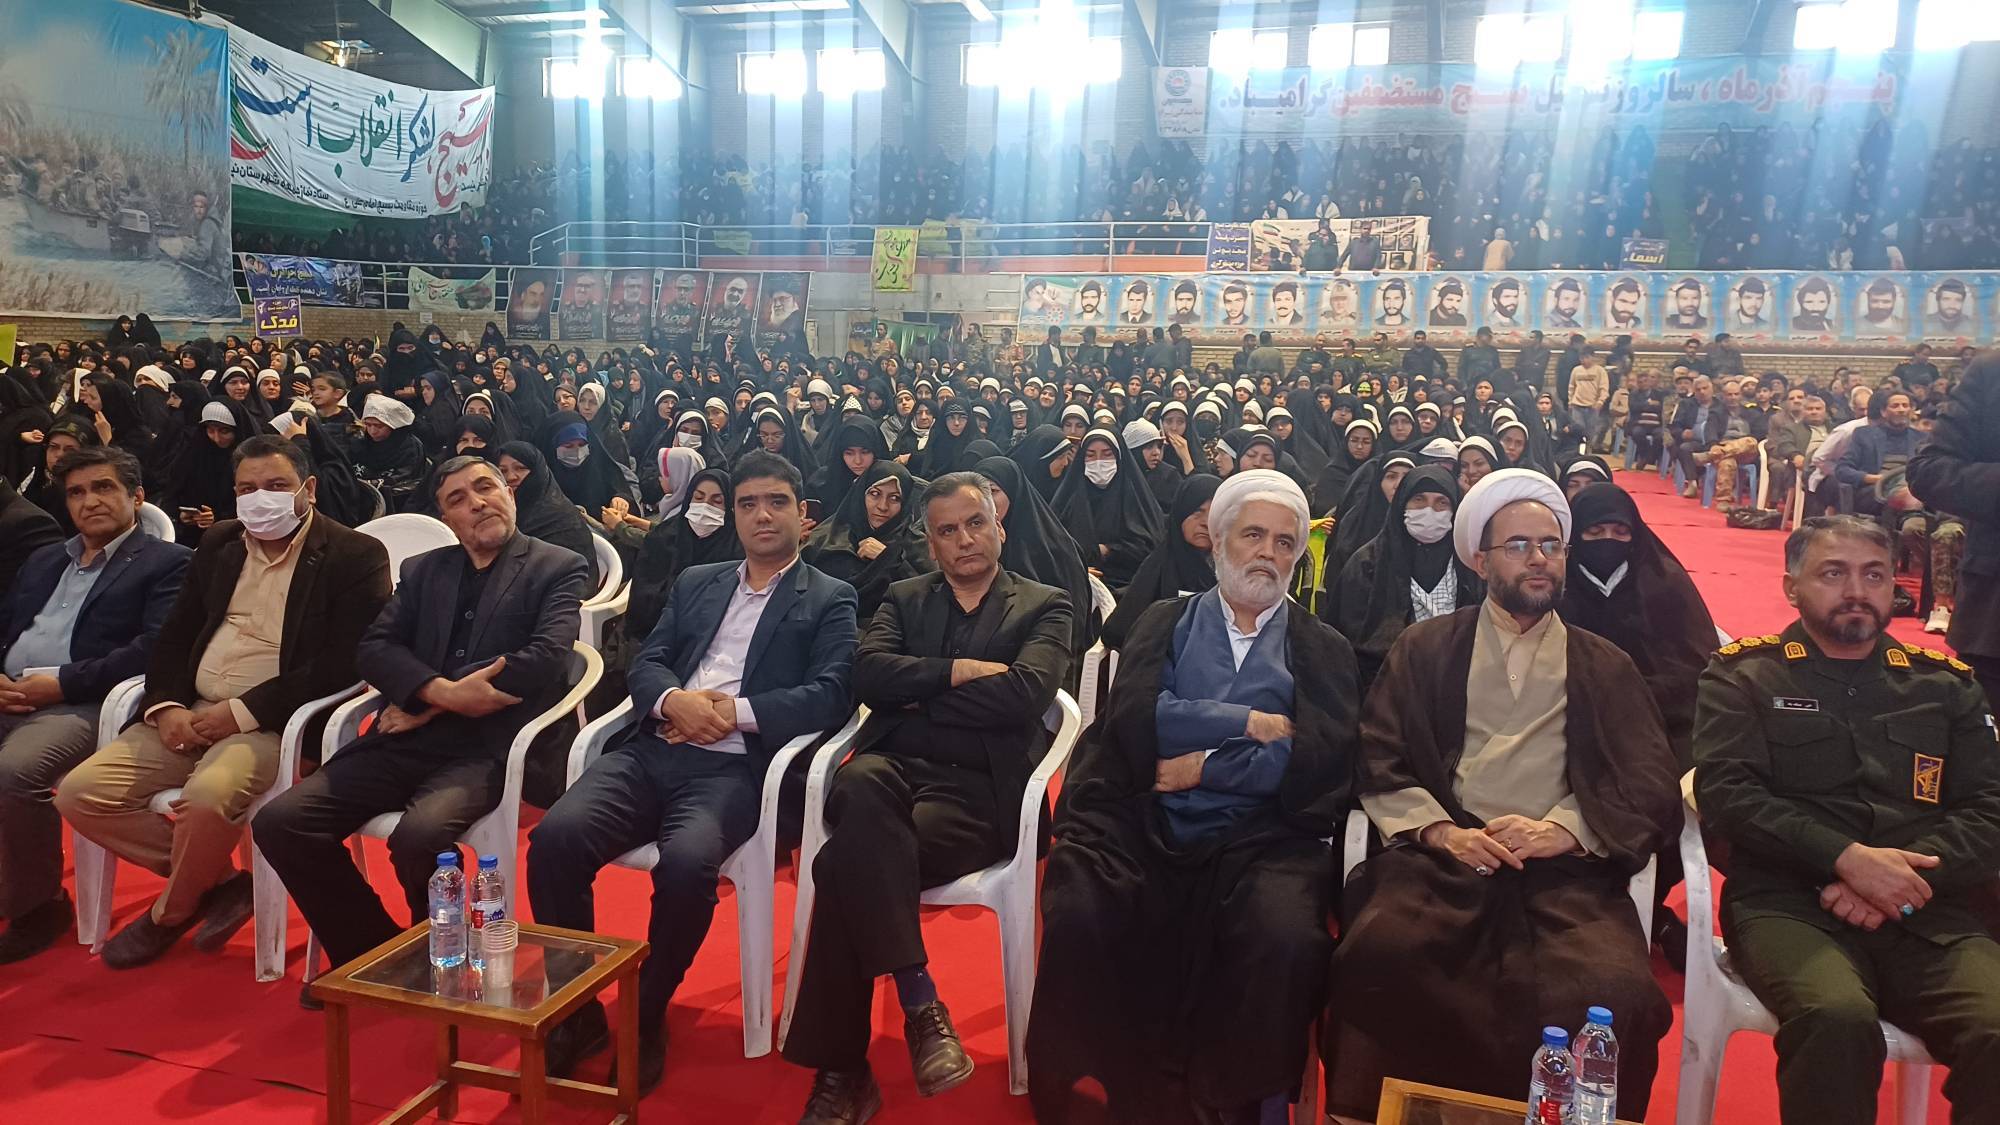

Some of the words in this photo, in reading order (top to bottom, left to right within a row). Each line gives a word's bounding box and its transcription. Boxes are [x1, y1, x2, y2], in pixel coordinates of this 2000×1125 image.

[235, 55, 312, 148] است
[1333, 77, 1445, 116] مستضعفین
[317, 89, 402, 179] انقلاب
[400, 92, 436, 183] لشکر
[239, 165, 280, 186] شهرستان
[313, 188, 329, 200] ستاد
[377, 200, 394, 215] بسیج
[260, 314, 298, 330] فدک
